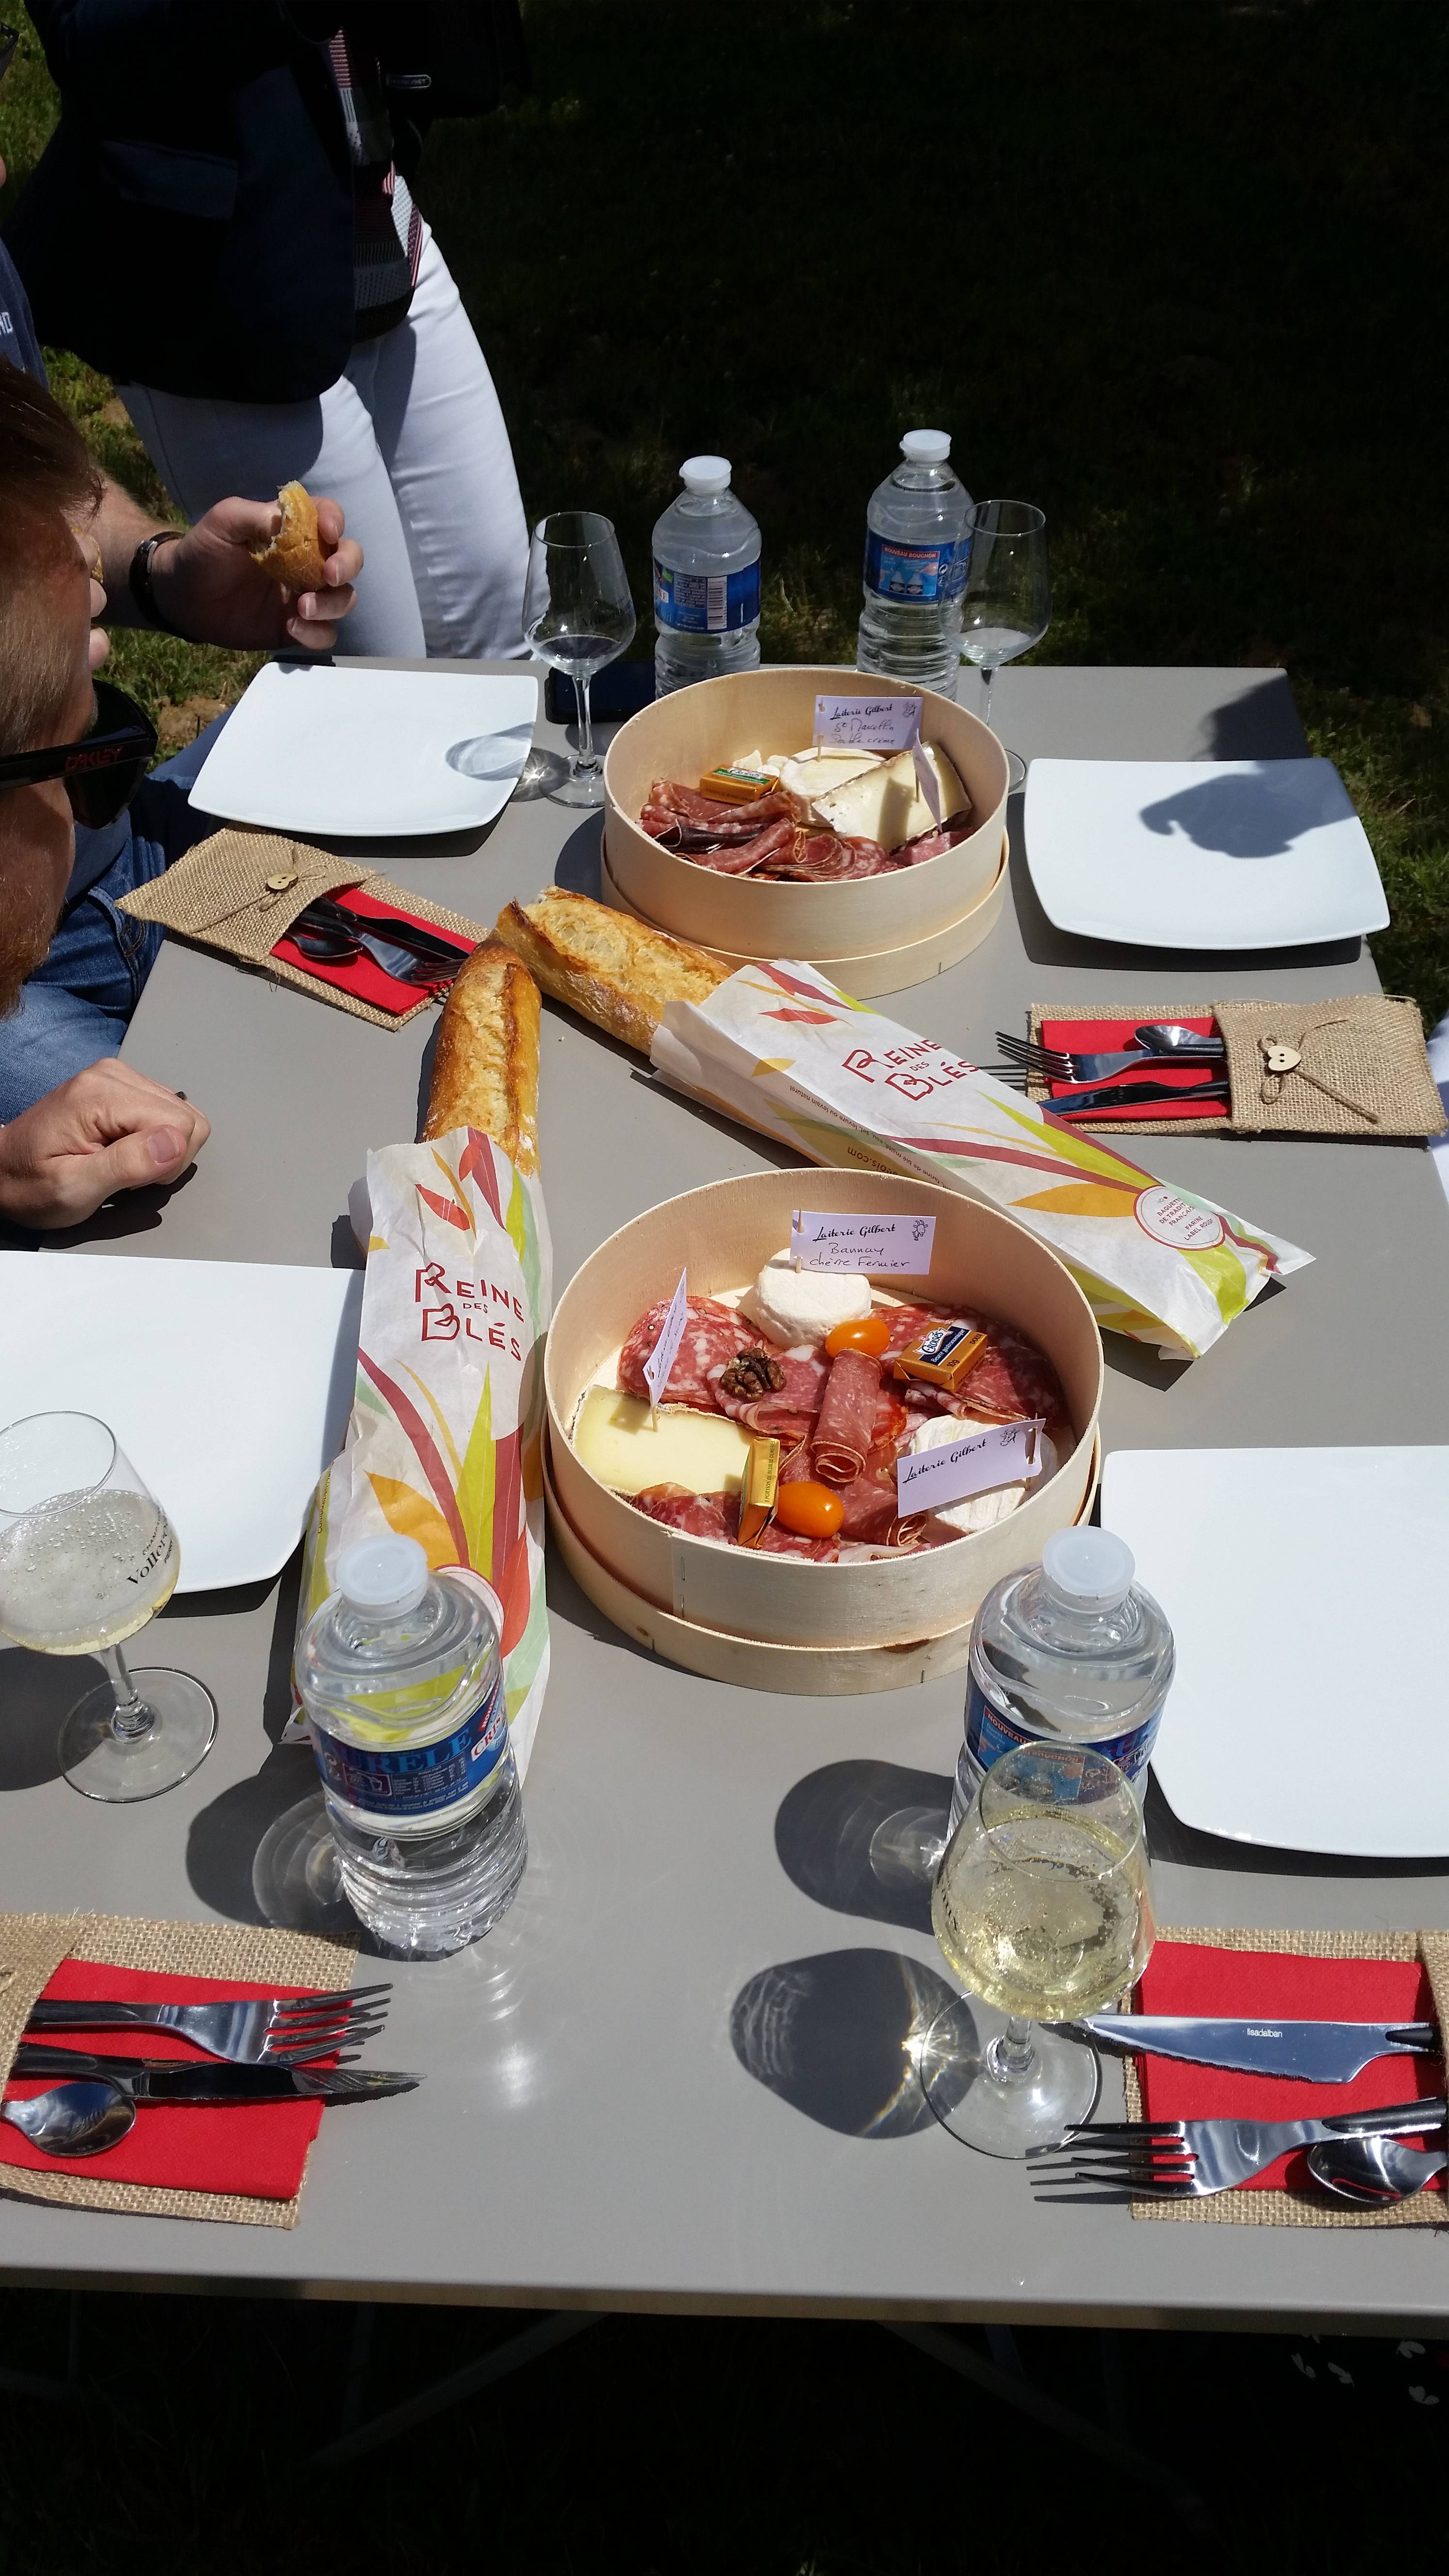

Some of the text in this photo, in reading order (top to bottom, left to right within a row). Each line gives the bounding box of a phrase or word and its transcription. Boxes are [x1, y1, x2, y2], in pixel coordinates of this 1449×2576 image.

[829, 703, 893, 720] Laiterie Gilbert
[841, 1039, 942, 1083] REINE
[909, 1061, 930, 1072] DES
[884, 1061, 979, 1101] BLÉS
[789, 1085, 810, 1101] naturel
[811, 1098, 829, 1113] levain
[1166, 1203, 1186, 1218] TRADIT
[1185, 1215, 1203, 1230] FARINE
[812, 1224, 896, 1243] Laiterie Gilbert
[1184, 1227, 1201, 1240] LABEL
[415, 1261, 524, 1323] REINE
[463, 1302, 488, 1314] DES
[421, 1303, 521, 1362] BLÉS
[969, 1333, 982, 1344] DOUX
[930, 1329, 966, 1363] Beurre gastronomique
[902, 1438, 986, 1484] Laiterie Gilbert
[1247, 2028, 1283, 2038] lisadalban
